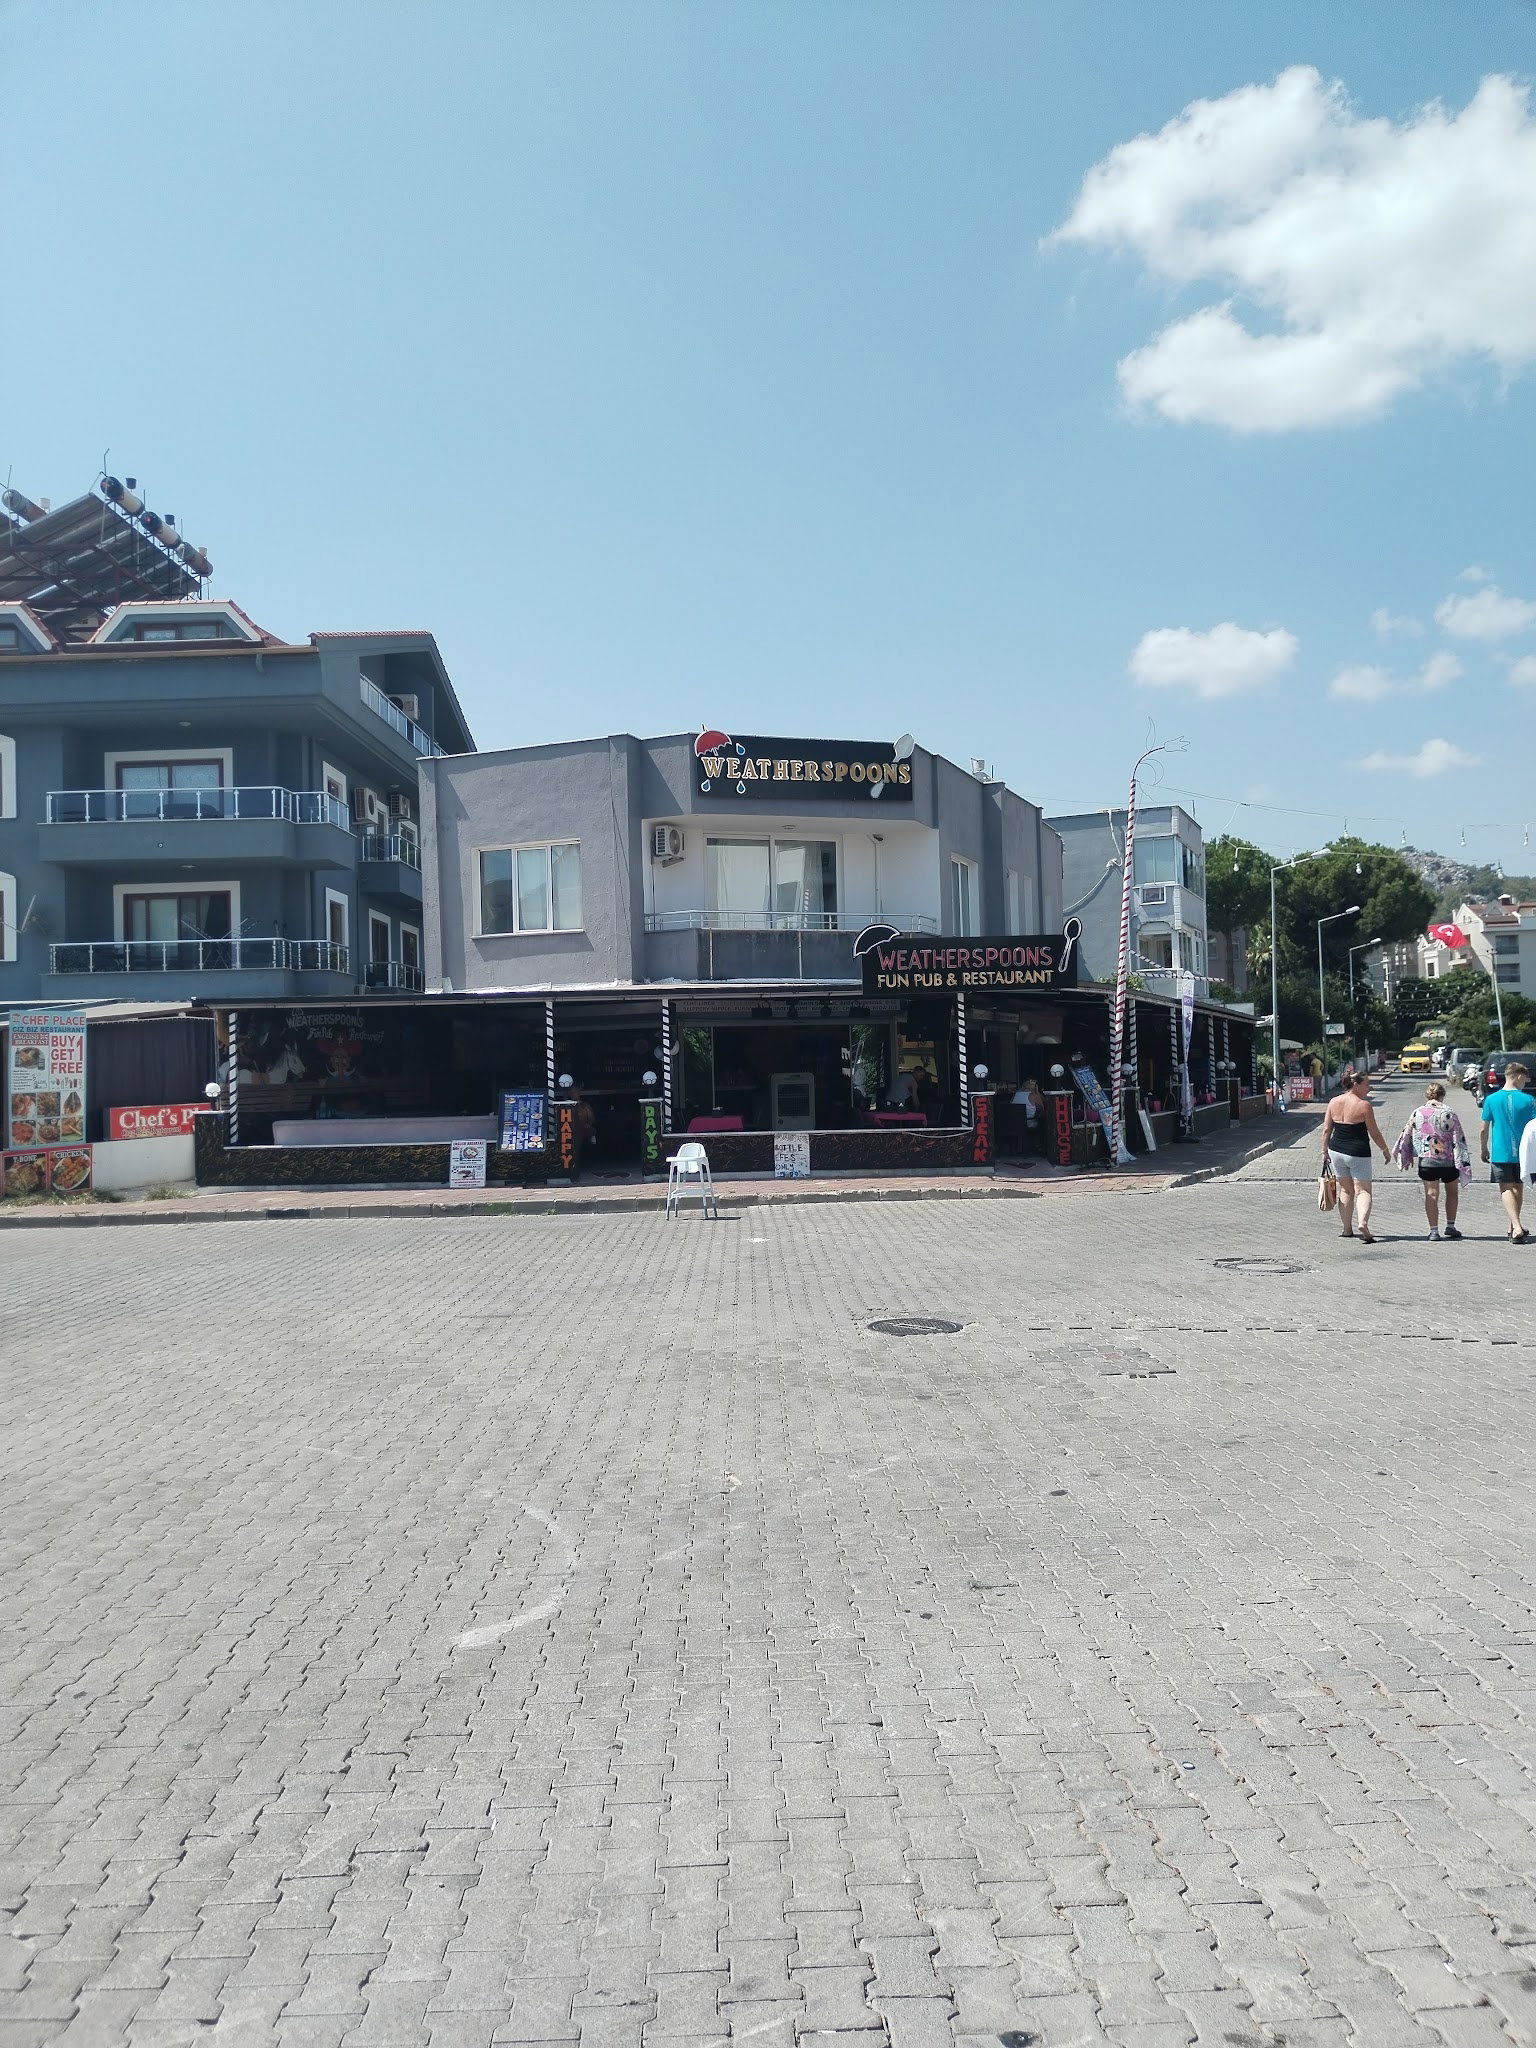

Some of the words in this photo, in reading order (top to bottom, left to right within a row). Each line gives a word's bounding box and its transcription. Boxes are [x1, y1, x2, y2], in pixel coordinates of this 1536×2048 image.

[701, 756, 911, 784] WEATHERSPOONS
[877, 946, 1053, 971] WEATHERSPOONS
[877, 974, 909, 988] FUN
[914, 973, 943, 987] PUB
[947, 973, 957, 986] &
[963, 970, 1054, 985] RESTAURANT
[22, 1015, 49, 1025] CHEF
[53, 1016, 85, 1026] PLACE
[51, 1035, 75, 1047] BUY
[76, 1035, 83, 1061] 1
[51, 1049, 74, 1060] GET
[51, 1062, 83, 1074] FREE
[1291, 1088, 1297, 1099] 3
[119, 1108, 178, 1129] Chef's
[973, 1096, 989, 1161] STEAK
[560, 1108, 573, 1169] HAPPY
[645, 1106, 658, 1159] DAYS
[1055, 1096, 1071, 1165] HOUSE
[55, 1150, 84, 1158] CHICKEN
[775, 1143, 803, 1152] BOTTLE
